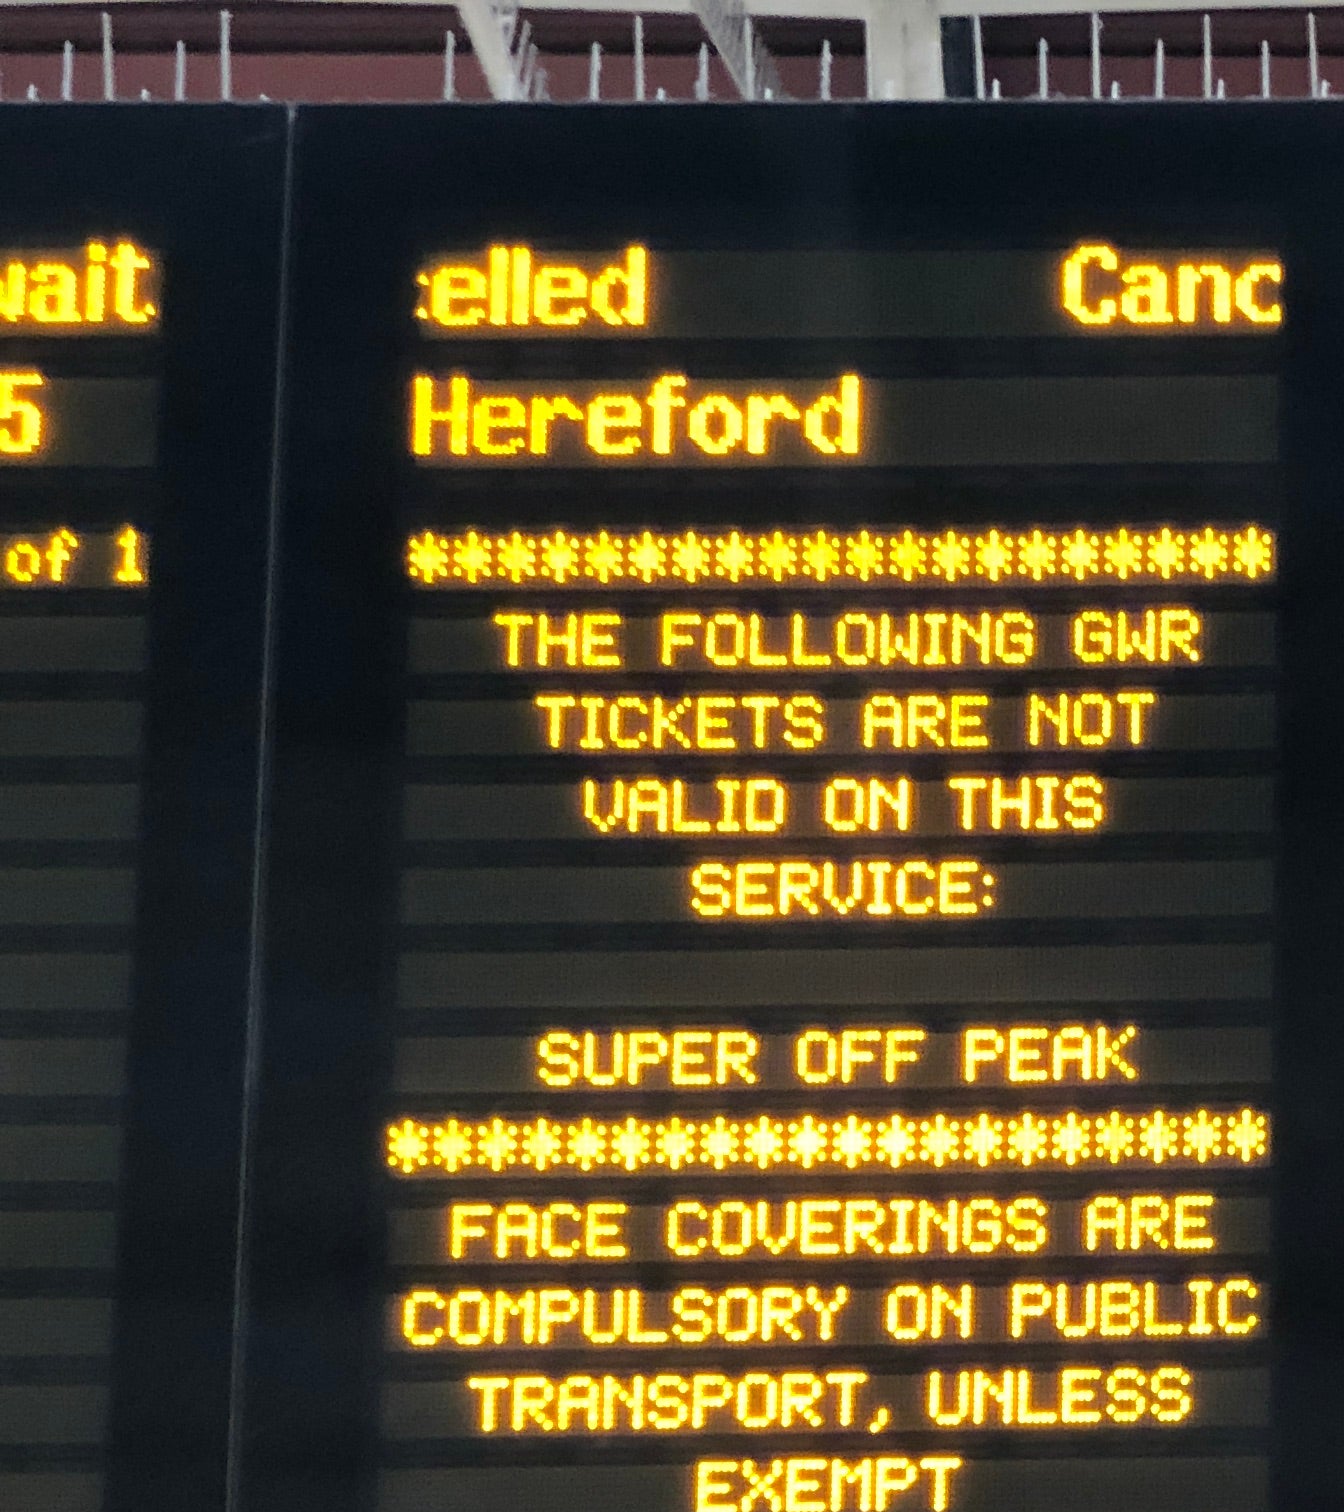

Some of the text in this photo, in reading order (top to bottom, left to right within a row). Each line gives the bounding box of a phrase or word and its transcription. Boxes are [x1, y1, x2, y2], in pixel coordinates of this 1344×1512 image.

[414, 244, 1283, 328] elled Canc
[411, 372, 863, 457] Hereford
[4, 526, 145, 584] of 1
[491, 607, 1202, 668] THE FOLLOWING GWR
[534, 691, 1156, 751] TICKETS ARE NOT
[582, 774, 1105, 835] VALID ON THIS
[689, 859, 996, 918] SERVICE:
[535, 1024, 1138, 1088] SUPER OFF PEAK
[448, 1193, 1216, 1260] FACE COVERINGS ARE
[401, 1278, 1259, 1348] COMPULSORY ON PUBLIC
[465, 1365, 1194, 1435] TRANSPORT, UNLESS
